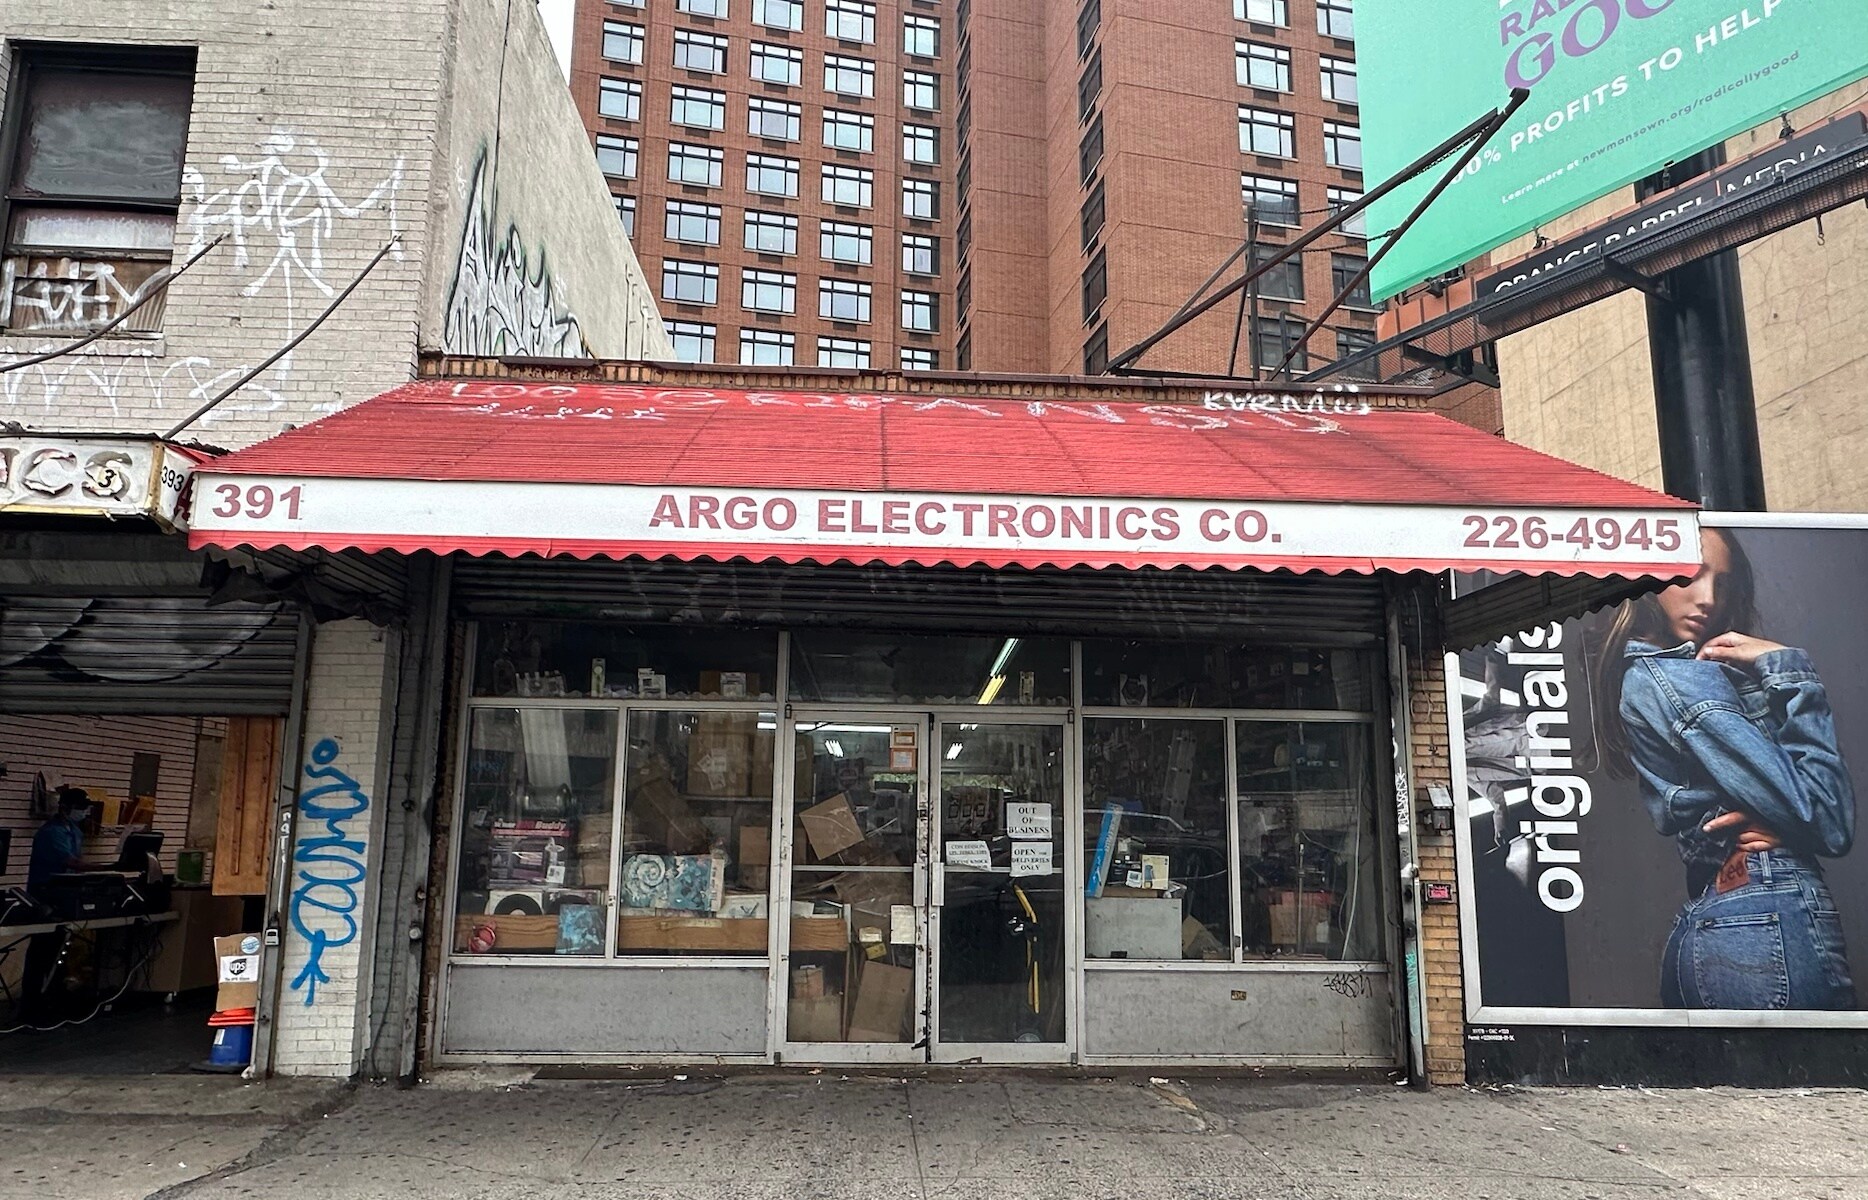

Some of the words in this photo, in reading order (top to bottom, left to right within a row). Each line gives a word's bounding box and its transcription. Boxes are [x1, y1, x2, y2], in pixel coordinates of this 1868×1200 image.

[1510, 75, 1628, 153] PROFITS
[1638, 47, 1682, 81] TO
[1502, 183, 1533, 204] Learn
[1566, 159, 1580, 172] at
[1582, 50, 1800, 164] newmansown.org/radicallygood
[161, 465, 185, 492] 393
[212, 483, 302, 520] 391
[648, 494, 797, 531] ARGO
[817, 499, 1180, 542] ELECTRONICS
[1199, 508, 1282, 543] CO.
[1462, 515, 1682, 551] 226-4945
[1018, 806, 1037, 815] OUT
[1008, 826, 1050, 834] BUSINESS
[1014, 848, 1036, 856] OPEN
[230, 962, 246, 974] ups
